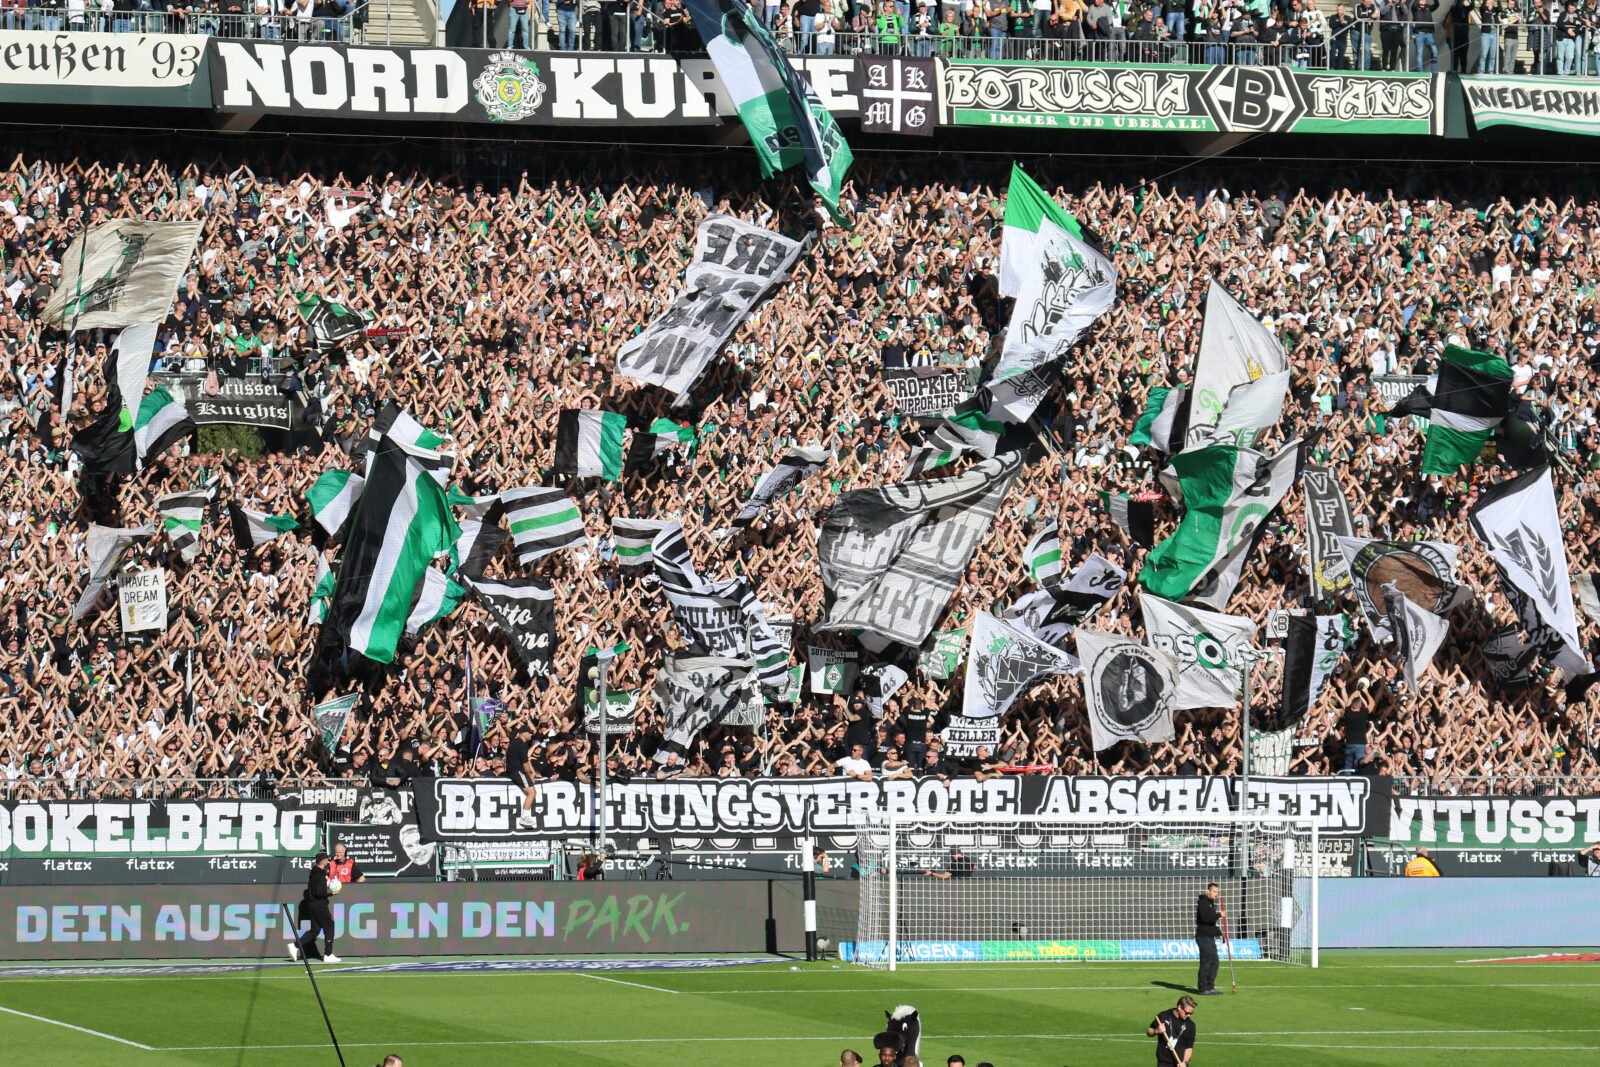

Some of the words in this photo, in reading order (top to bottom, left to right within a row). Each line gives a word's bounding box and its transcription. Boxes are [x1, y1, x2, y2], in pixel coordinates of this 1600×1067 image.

[2, 34, 128, 80] eußen
[219, 42, 468, 113] NORD
[550, 58, 859, 118] KURE
[946, 68, 1189, 116] BORUSSIA
[1309, 77, 1434, 121] FANS
[990, 113, 1057, 126] IMMER
[1069, 116, 1104, 127] UND
[1115, 115, 1206, 129] ÜBERALL!
[196, 378, 283, 397] Brussen
[887, 375, 967, 398] DROPKICK
[1375, 382, 1418, 397] BORUS
[898, 393, 960, 413] UPPORTERS
[195, 402, 287, 419] Knights
[121, 577, 125, 588] I
[126, 576, 148, 588] HAVE
[152, 574, 160, 586] A
[124, 590, 158, 603] DREAM
[948, 729, 996, 742] KELLER
[946, 744, 995, 757] FLUTN
[303, 788, 357, 804] BANDA
[1041, 779, 1364, 827] ABSCHAFFEN
[126, 858, 175, 870] flatex
[208, 857, 256, 870] flatex
[784, 854, 844, 868] flex
[979, 854, 1038, 867] flatex
[1075, 853, 1133, 867] flatex
[1170, 853, 1228, 867] flatex
[1457, 852, 1501, 863] flatex
[1532, 852, 1575, 863] flatex
[43, 859, 92, 871] flatex
[17, 905, 141, 942] DEIN
[155, 904, 377, 940] AUSFLUG
[390, 903, 448, 939] IN
[462, 901, 554, 937] DEN
[563, 891, 690, 944] PARK.
